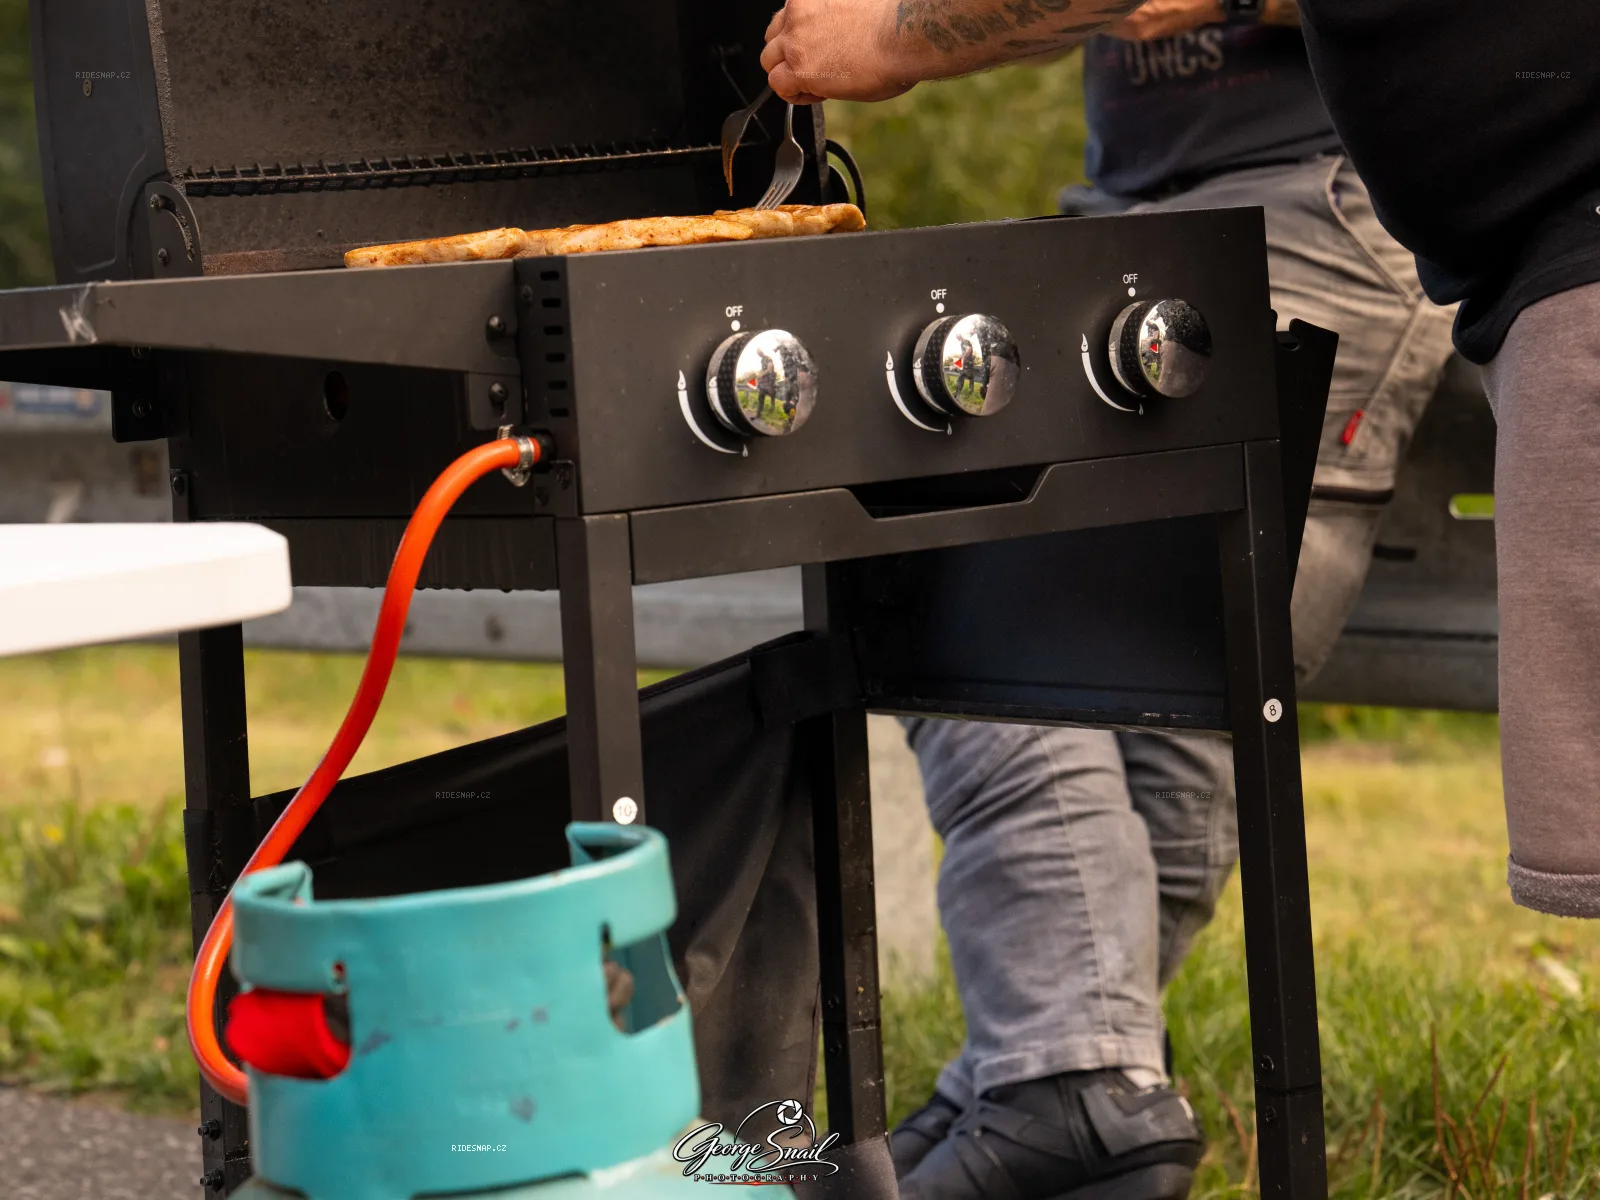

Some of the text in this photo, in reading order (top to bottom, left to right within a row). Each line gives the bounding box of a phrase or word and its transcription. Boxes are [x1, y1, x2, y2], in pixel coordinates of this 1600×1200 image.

[1122, 273, 1138, 284] OFF
[930, 288, 947, 300] OFF
[725, 305, 743, 318] OFF
